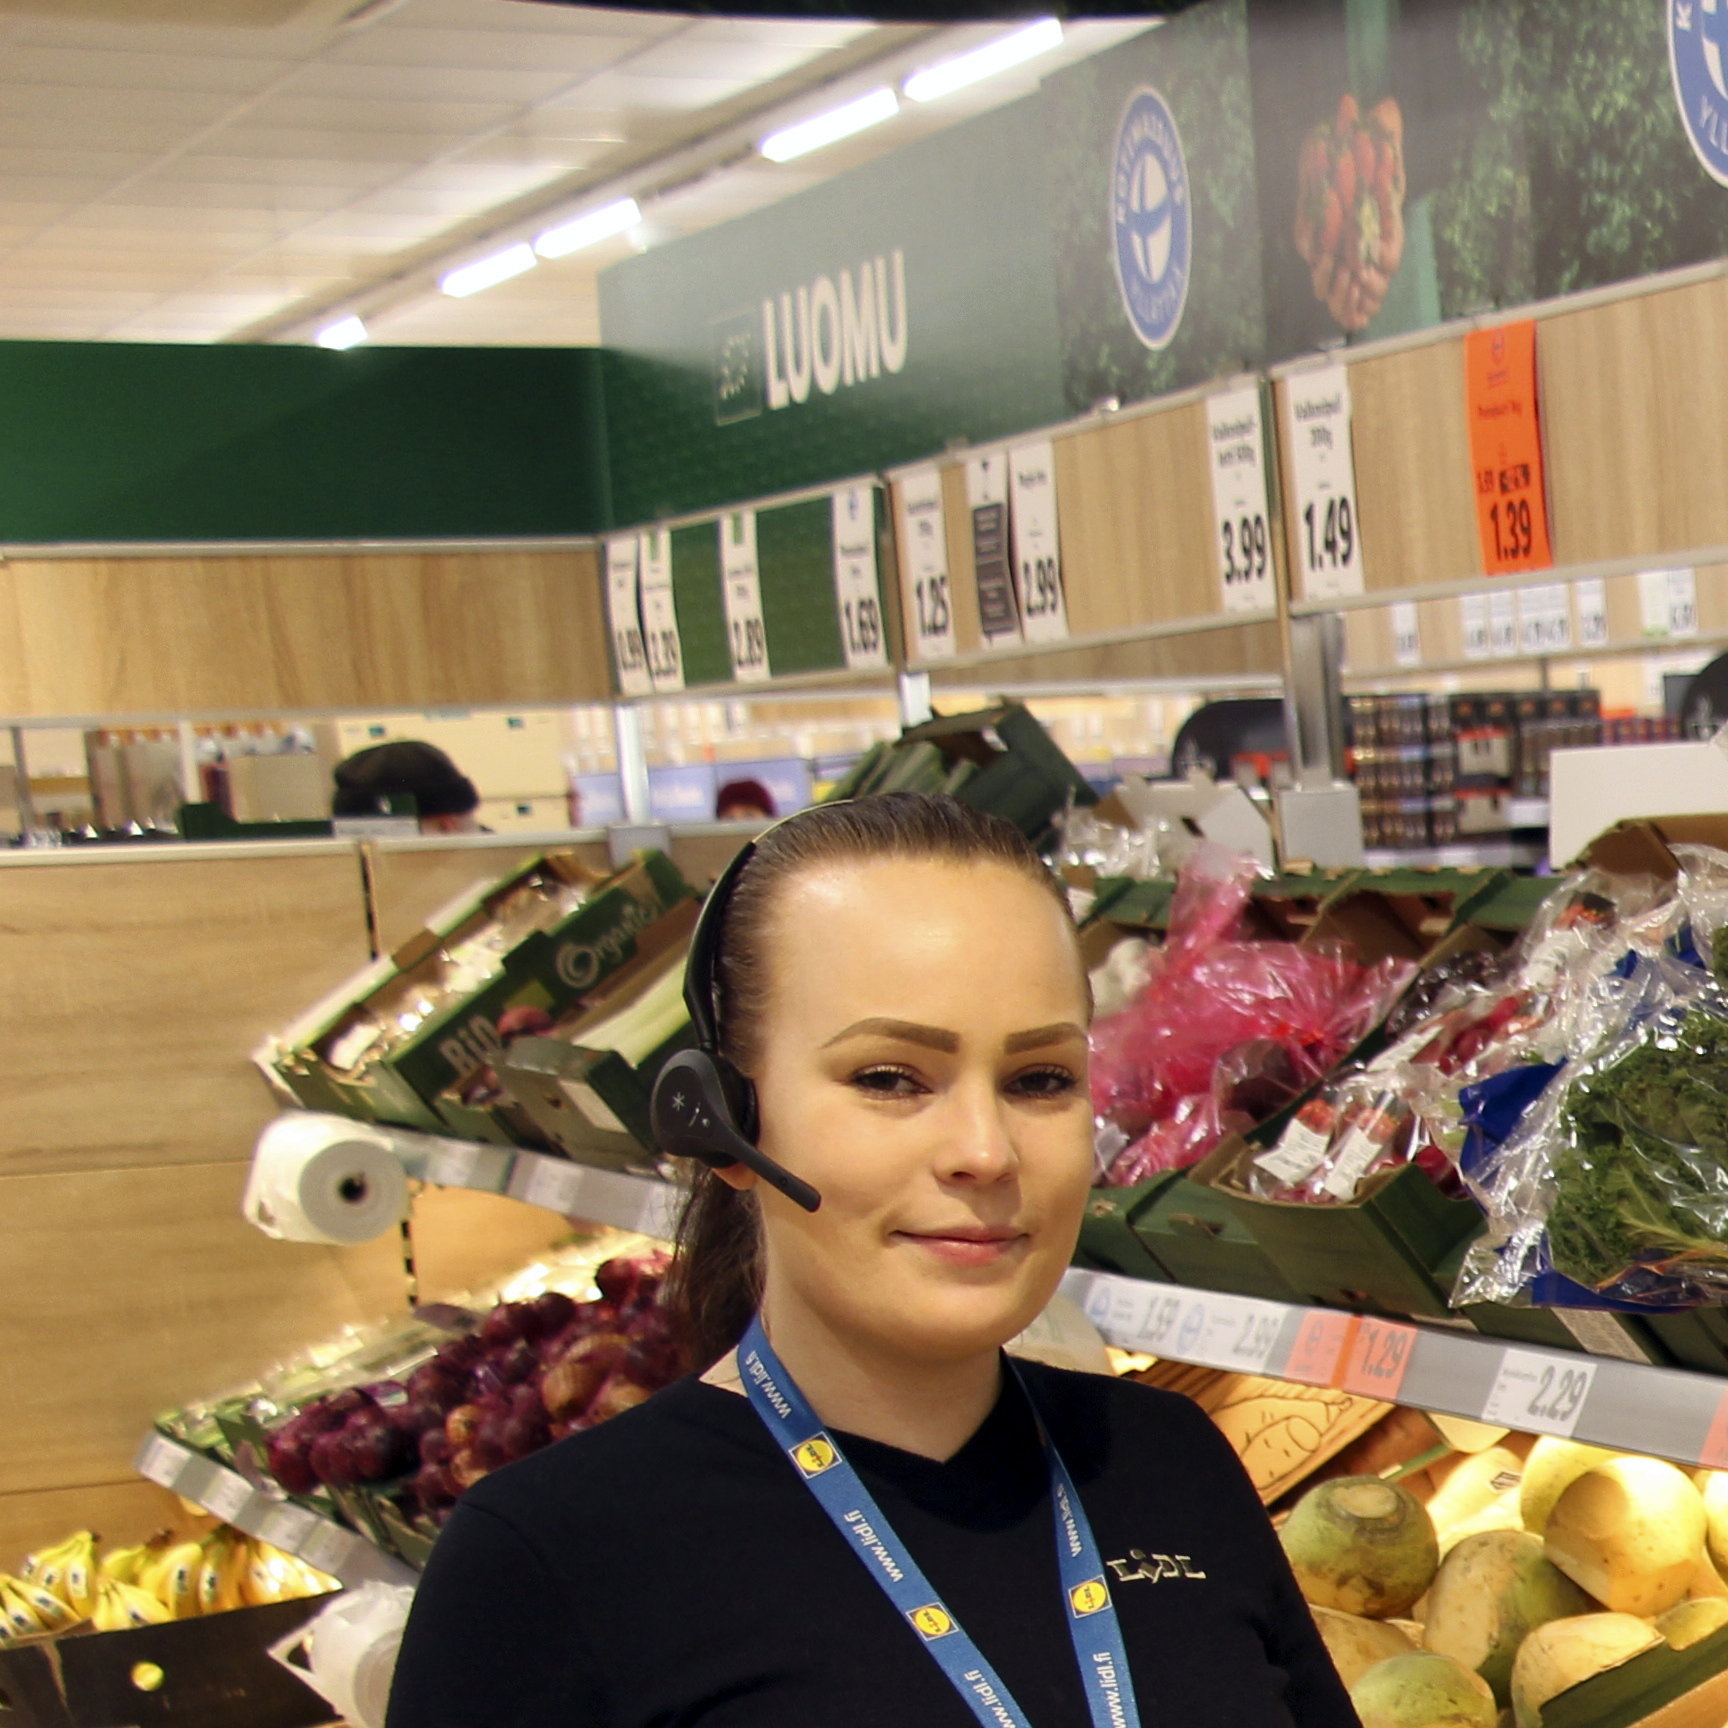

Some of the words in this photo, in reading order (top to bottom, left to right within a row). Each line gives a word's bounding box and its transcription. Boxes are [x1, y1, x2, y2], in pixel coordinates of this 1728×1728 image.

[764, 250, 906, 409] LUOMU
[1223, 514, 1267, 584] 3.99
[1305, 496, 1352, 572] 1.49
[1491, 498, 1531, 562] 1.39
[1527, 1365, 1588, 1422] 2.29
[843, 1509, 904, 1583] www.lidl.fi
